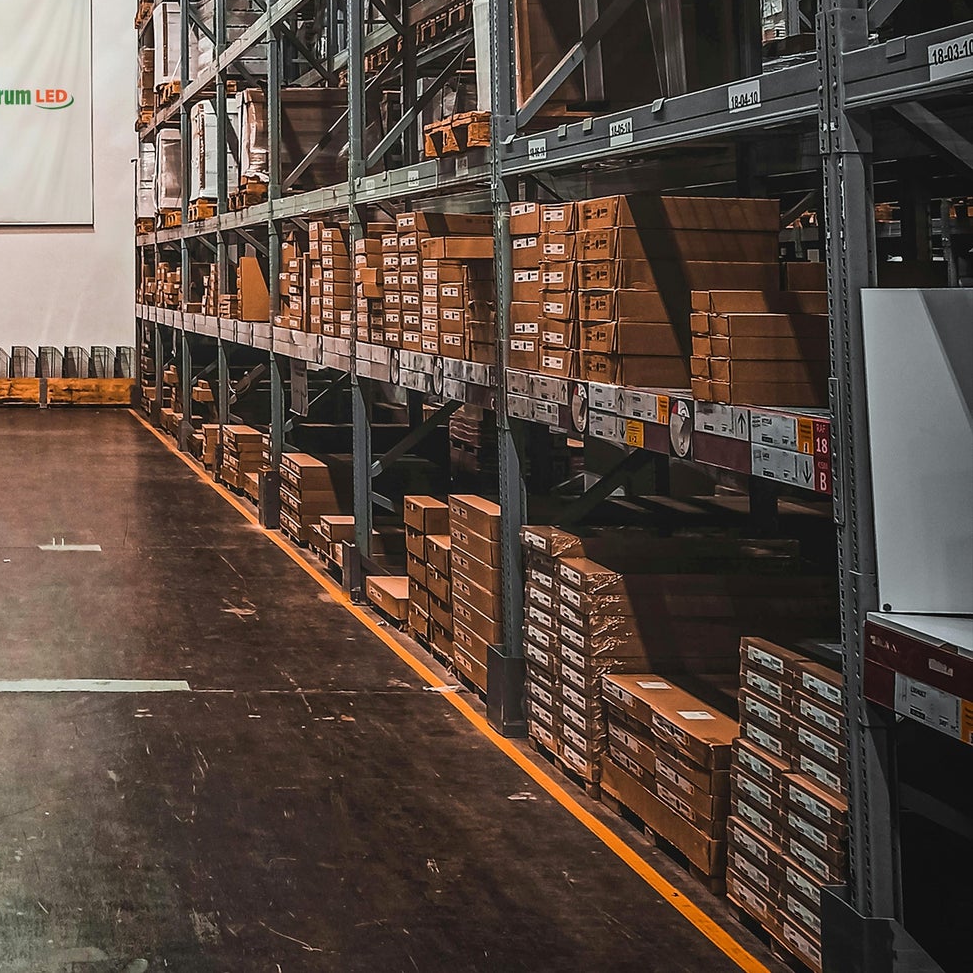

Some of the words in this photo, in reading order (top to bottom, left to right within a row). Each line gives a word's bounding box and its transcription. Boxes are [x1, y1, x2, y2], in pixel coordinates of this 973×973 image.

[35, 89, 68, 103] LED
[816, 438, 828, 454] 18
[819, 472, 827, 491] B
